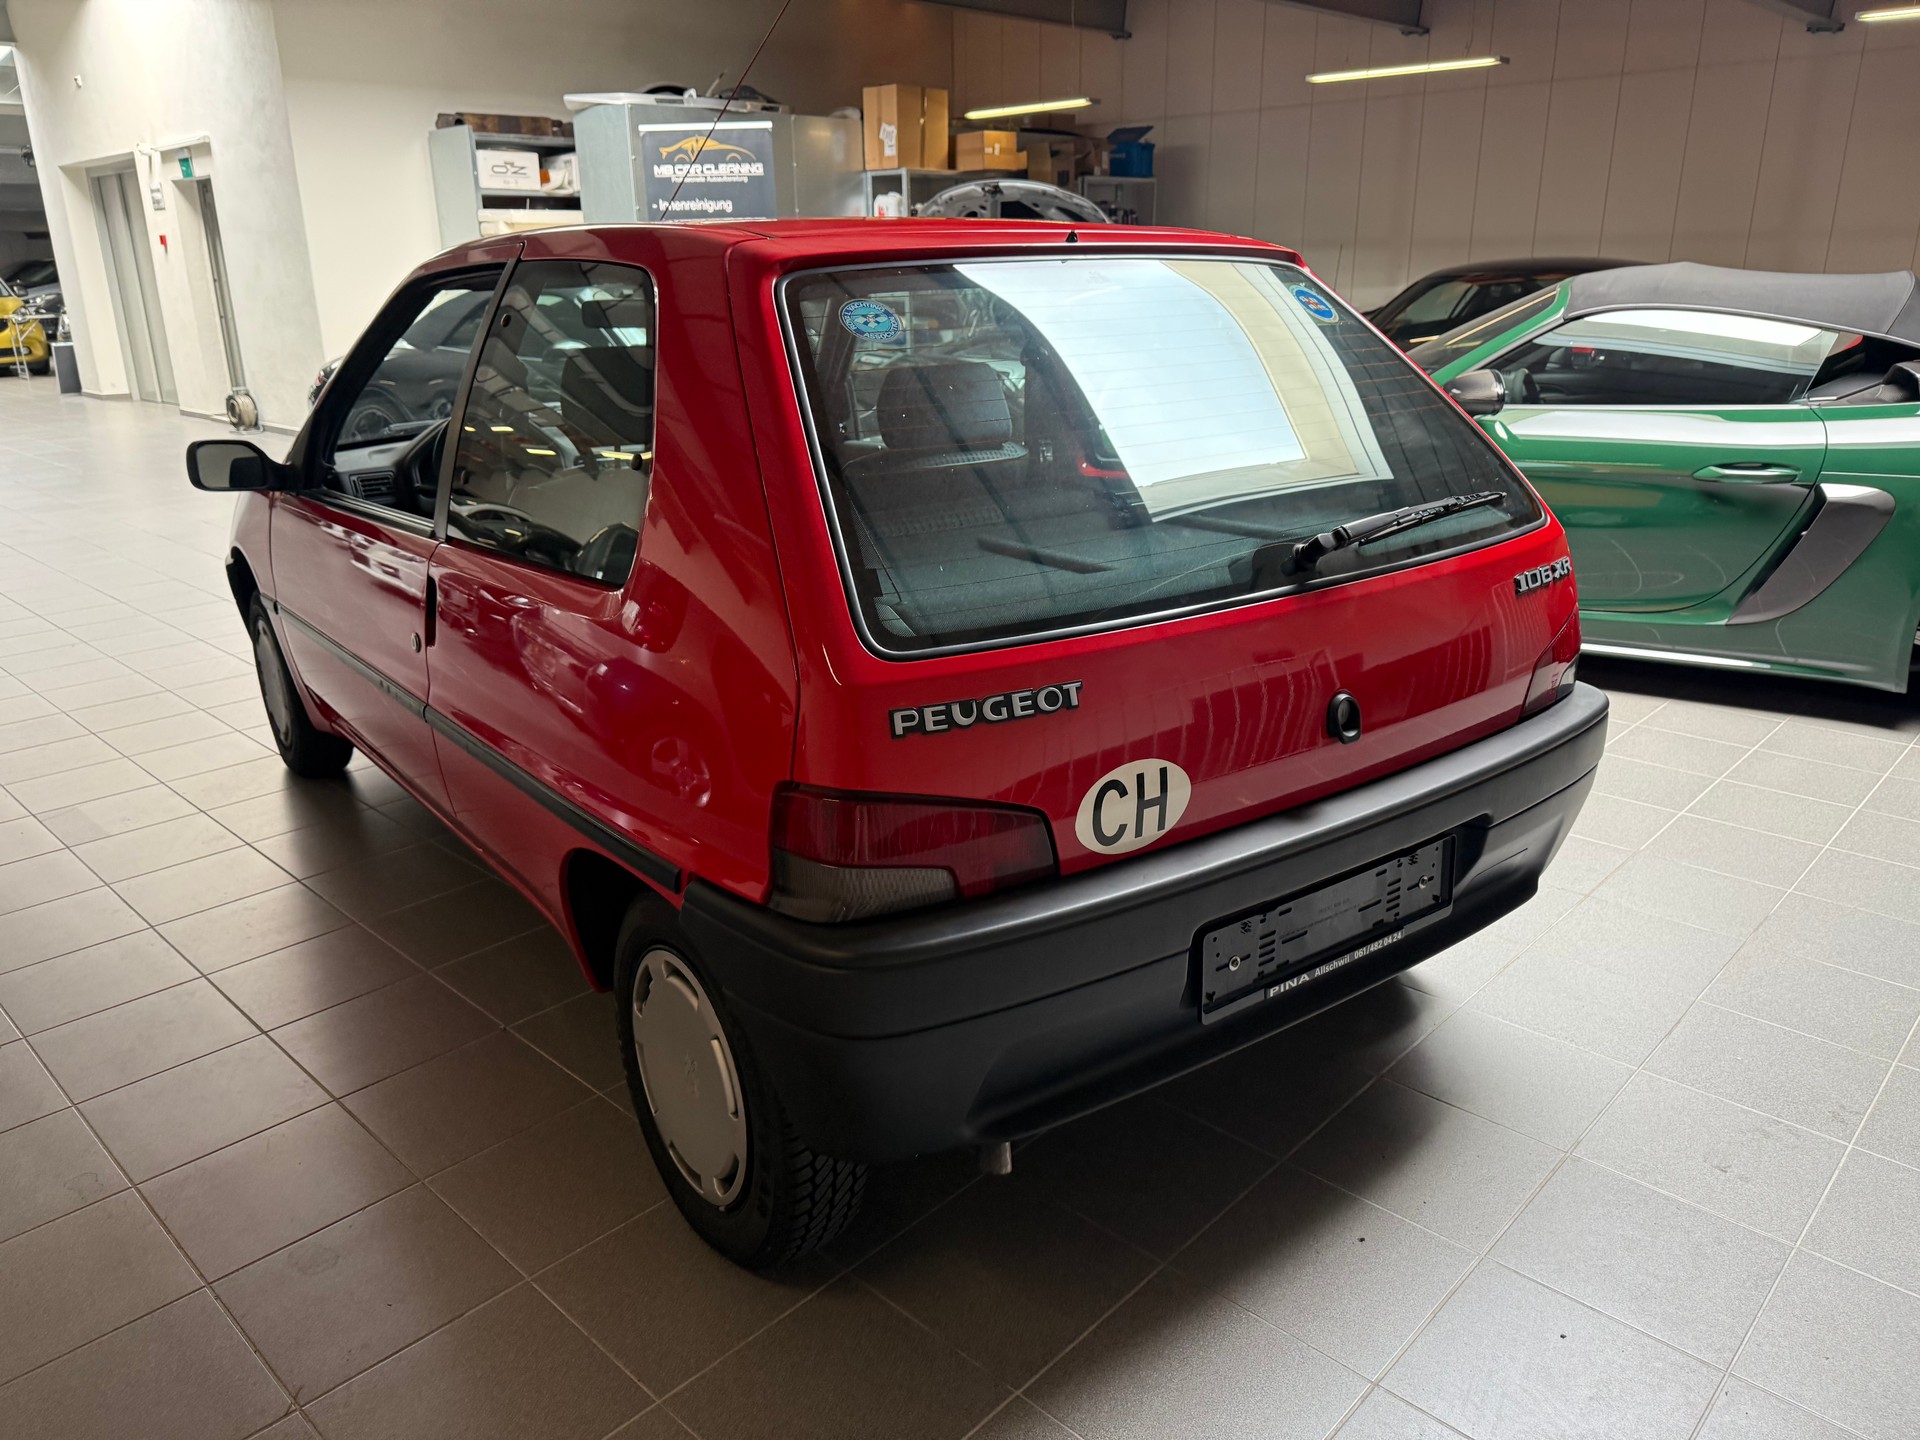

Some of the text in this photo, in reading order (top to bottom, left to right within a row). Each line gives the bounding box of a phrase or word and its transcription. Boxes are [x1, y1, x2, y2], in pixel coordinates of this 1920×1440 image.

[702, 163, 764, 176] CLEANING
[892, 681, 1083, 736] PEUGEOT
[1092, 767, 1168, 847] CH
[1270, 974, 1310, 997] PINA
[1314, 955, 1350, 977] Allschwil
[1354, 940, 1383, 959] 061/482
